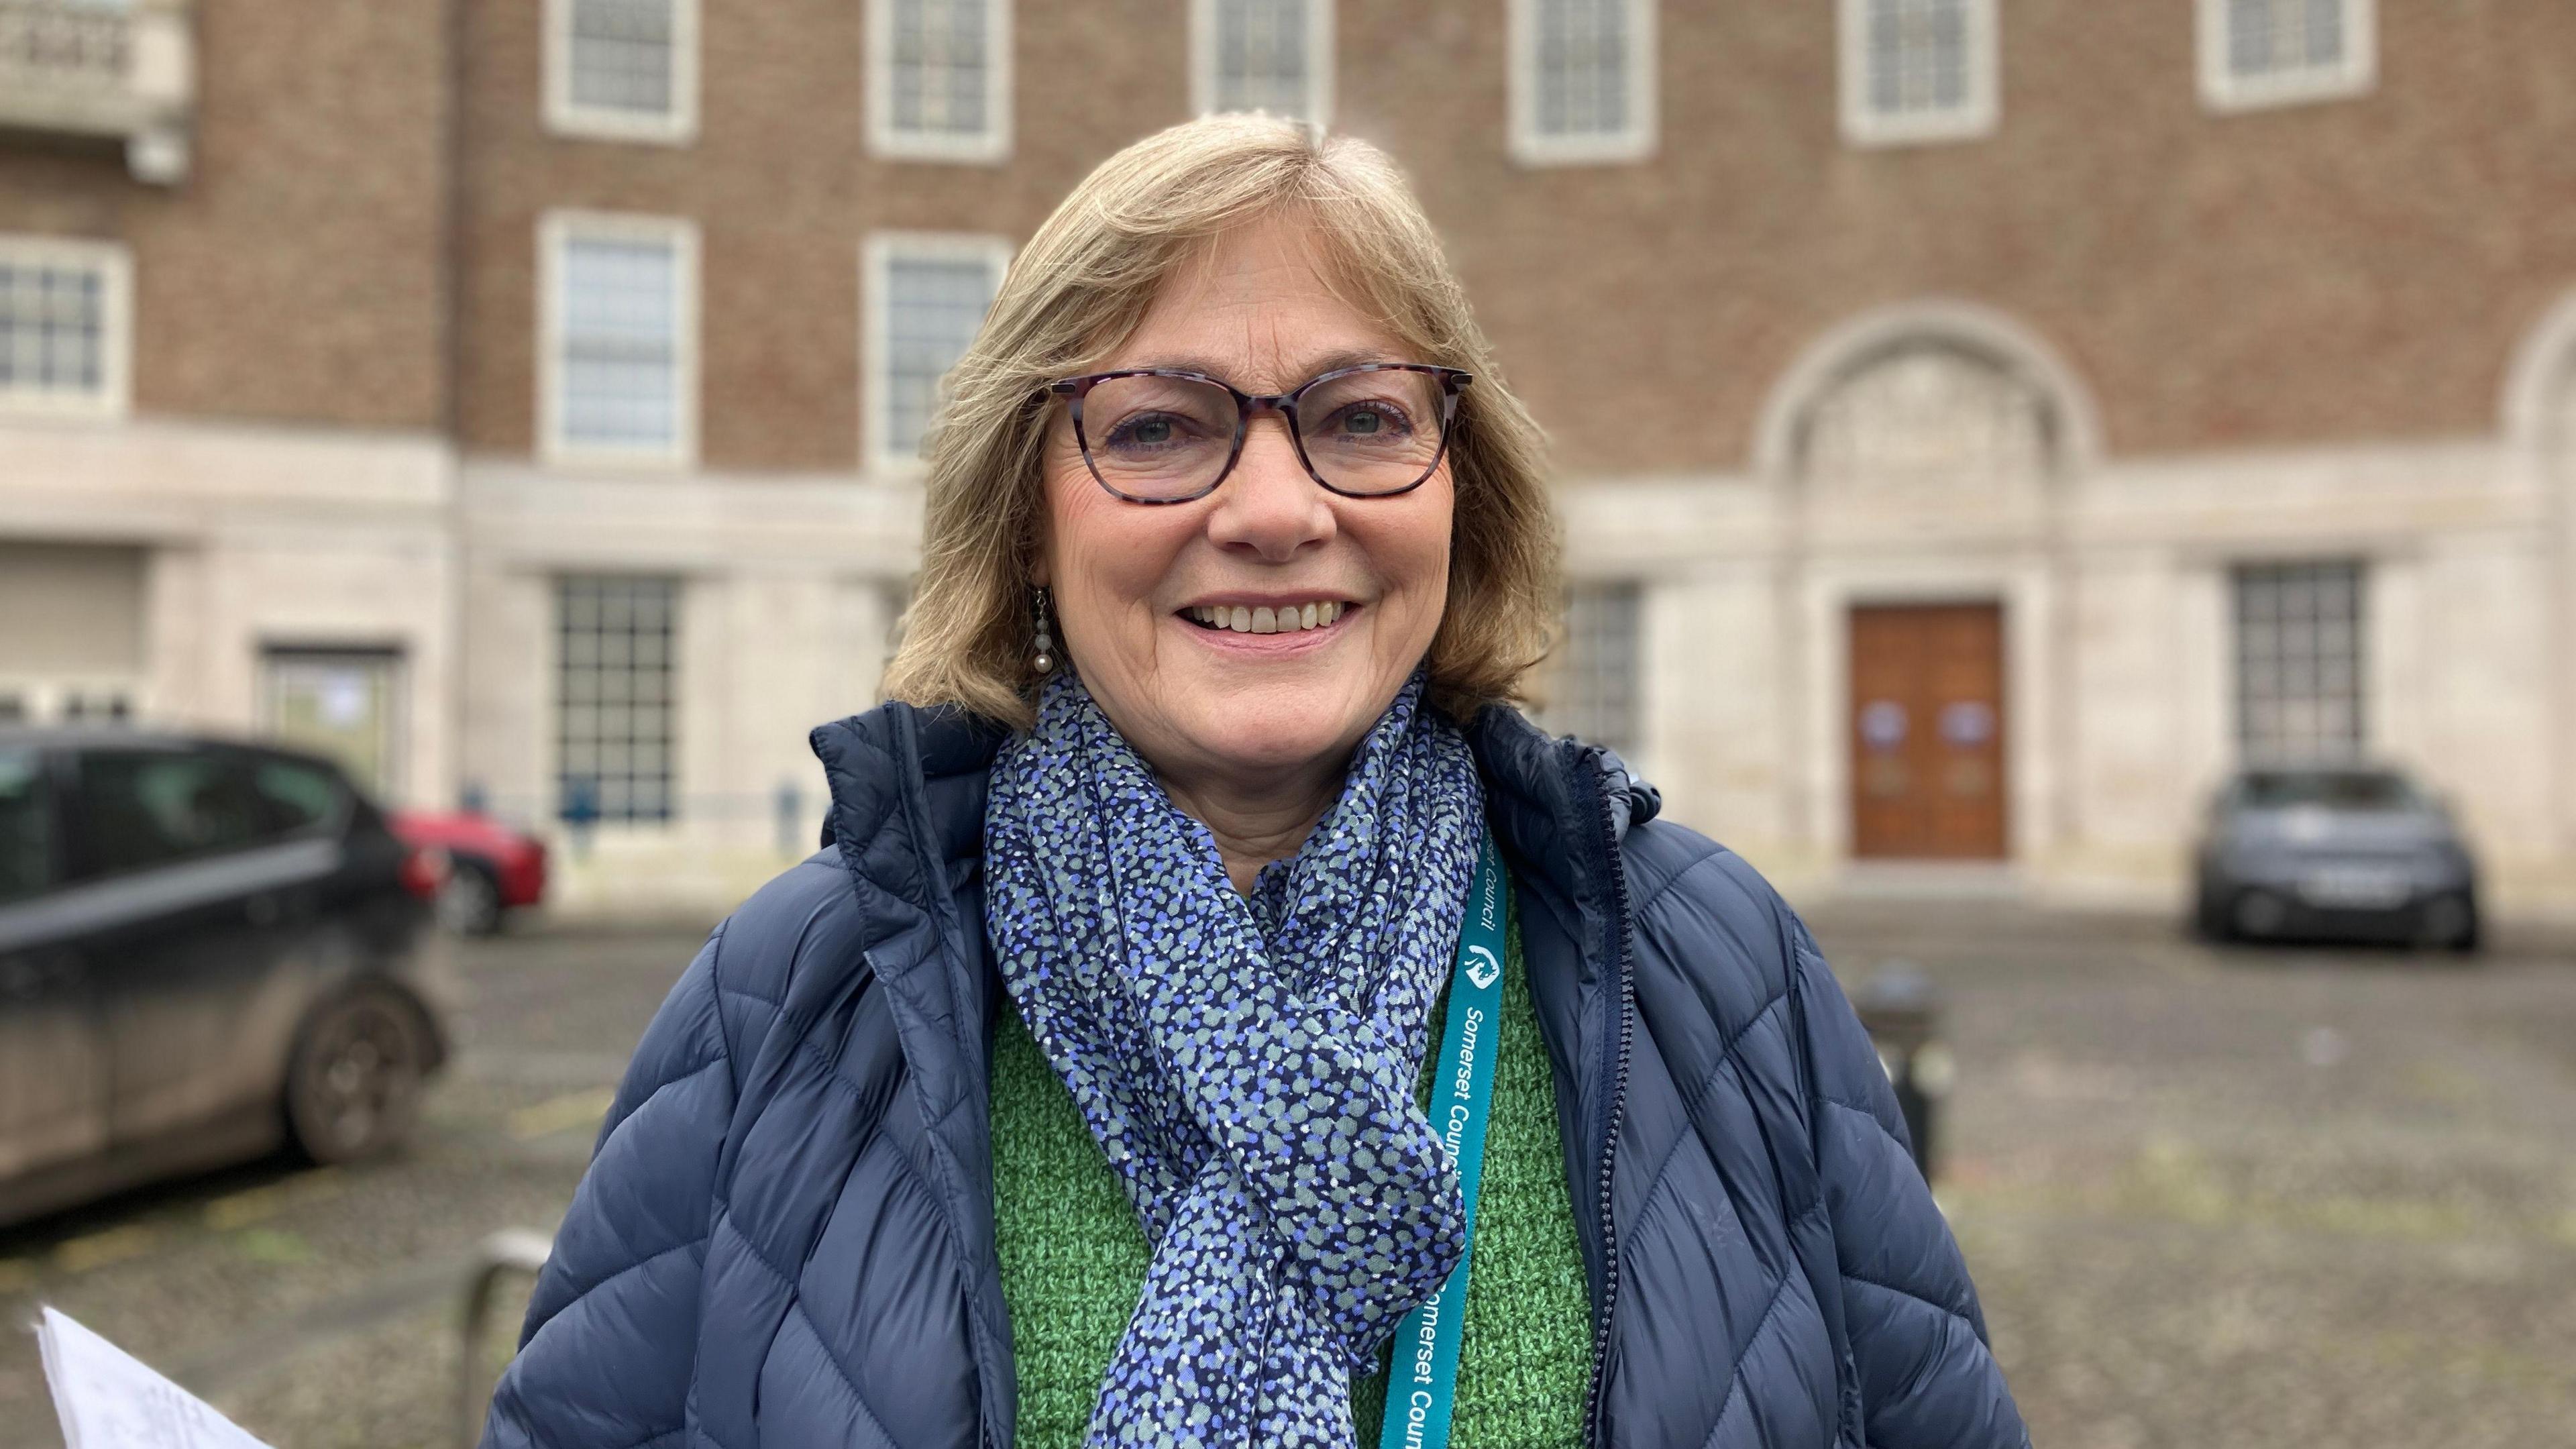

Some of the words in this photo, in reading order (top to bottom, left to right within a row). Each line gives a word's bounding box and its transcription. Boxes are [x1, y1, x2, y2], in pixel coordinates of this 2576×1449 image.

[1481, 867, 1497, 931] Council
[1454, 1006, 1484, 1101] Somerset
[1413, 1283, 1447, 1385] omerset
